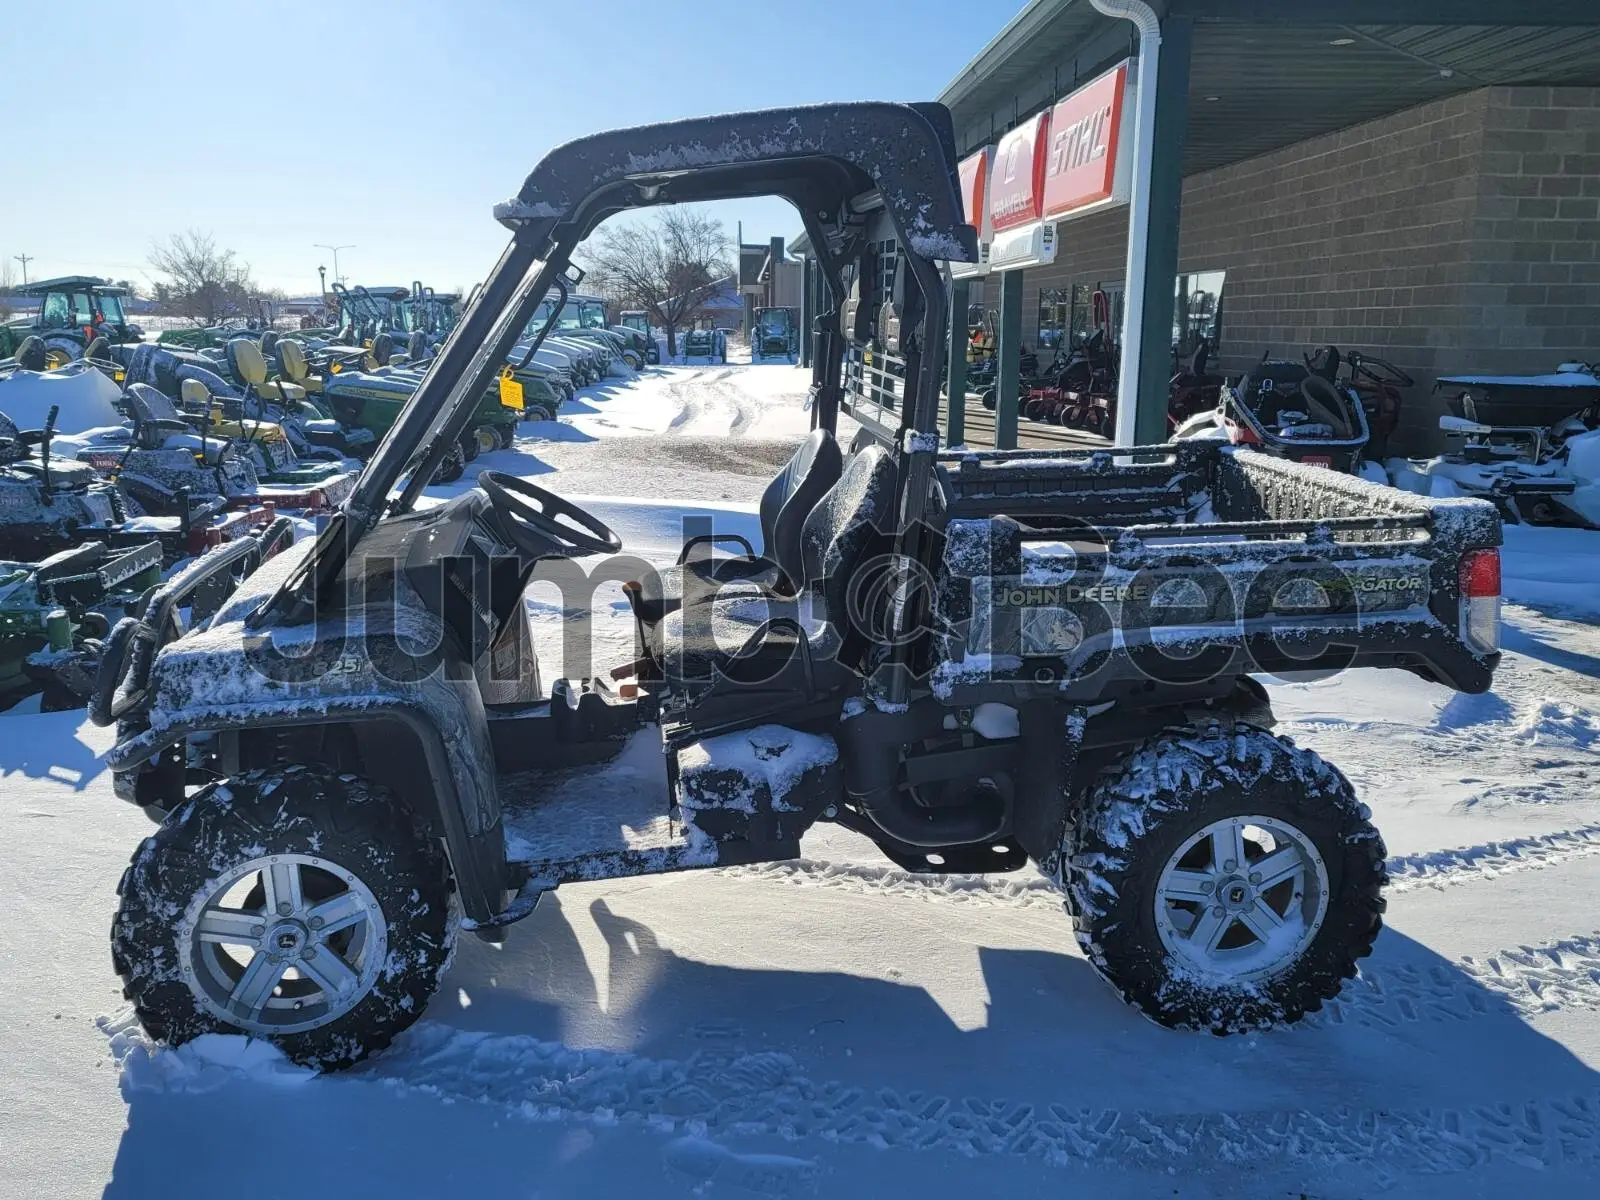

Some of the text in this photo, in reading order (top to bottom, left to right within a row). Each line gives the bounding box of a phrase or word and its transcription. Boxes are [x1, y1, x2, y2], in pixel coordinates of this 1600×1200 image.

[1048, 106, 1105, 178] STIHL
[995, 584, 1148, 606] JOHN DEERE
[1361, 577, 1422, 591] GATOR
